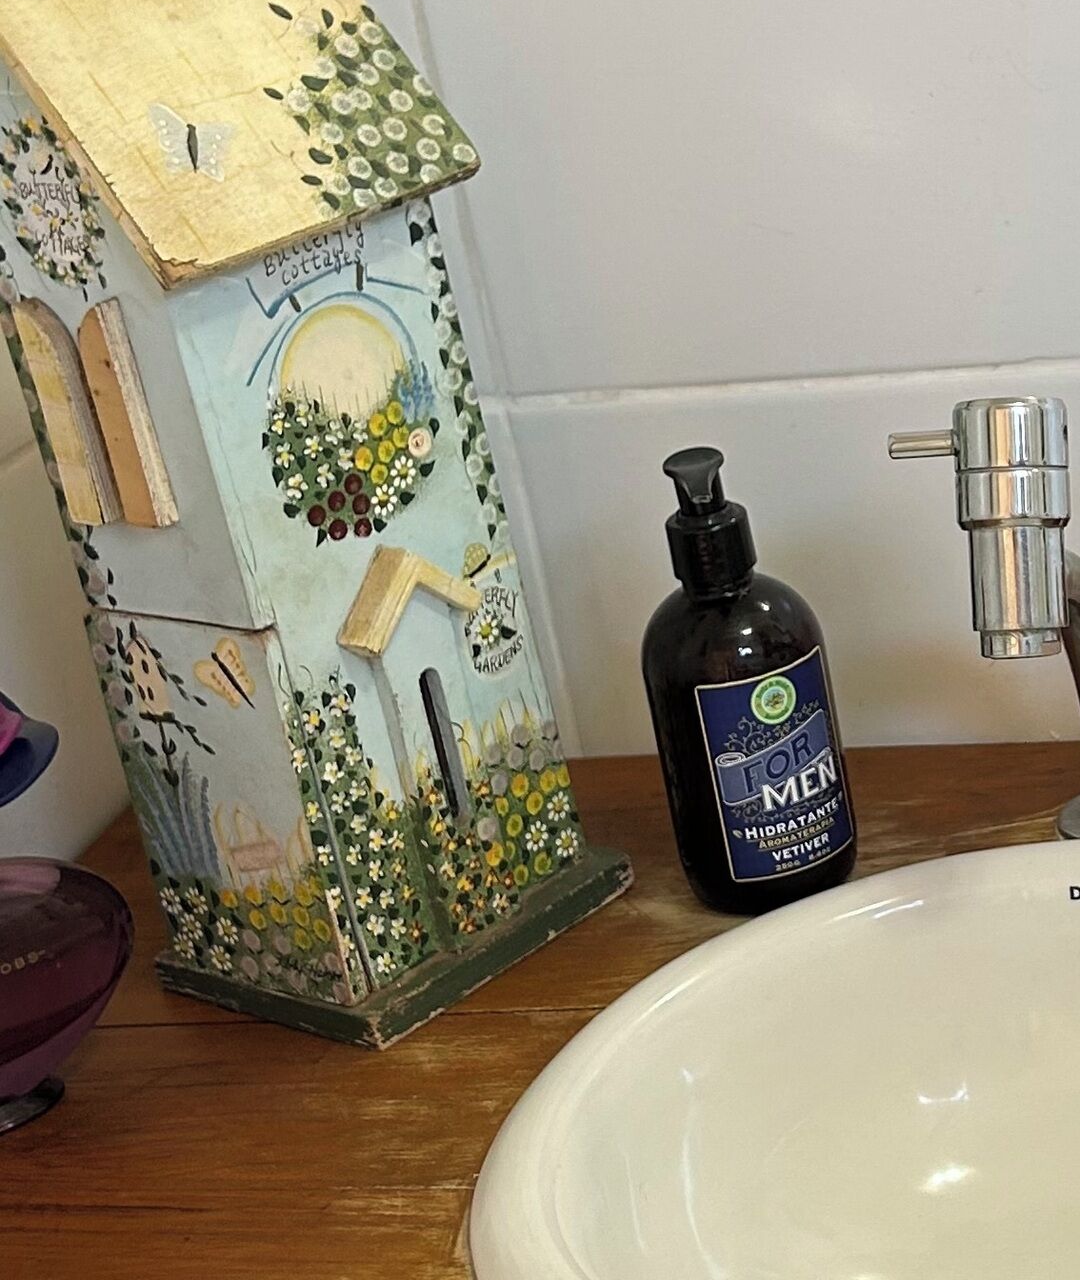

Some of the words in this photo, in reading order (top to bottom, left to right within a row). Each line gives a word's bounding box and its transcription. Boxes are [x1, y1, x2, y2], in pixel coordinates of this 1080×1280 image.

[742, 731, 812, 794] FOR
[762, 754, 839, 811] MEN
[744, 798, 839, 840] HIDRATANTE
[772, 832, 830, 862] VETIVER
